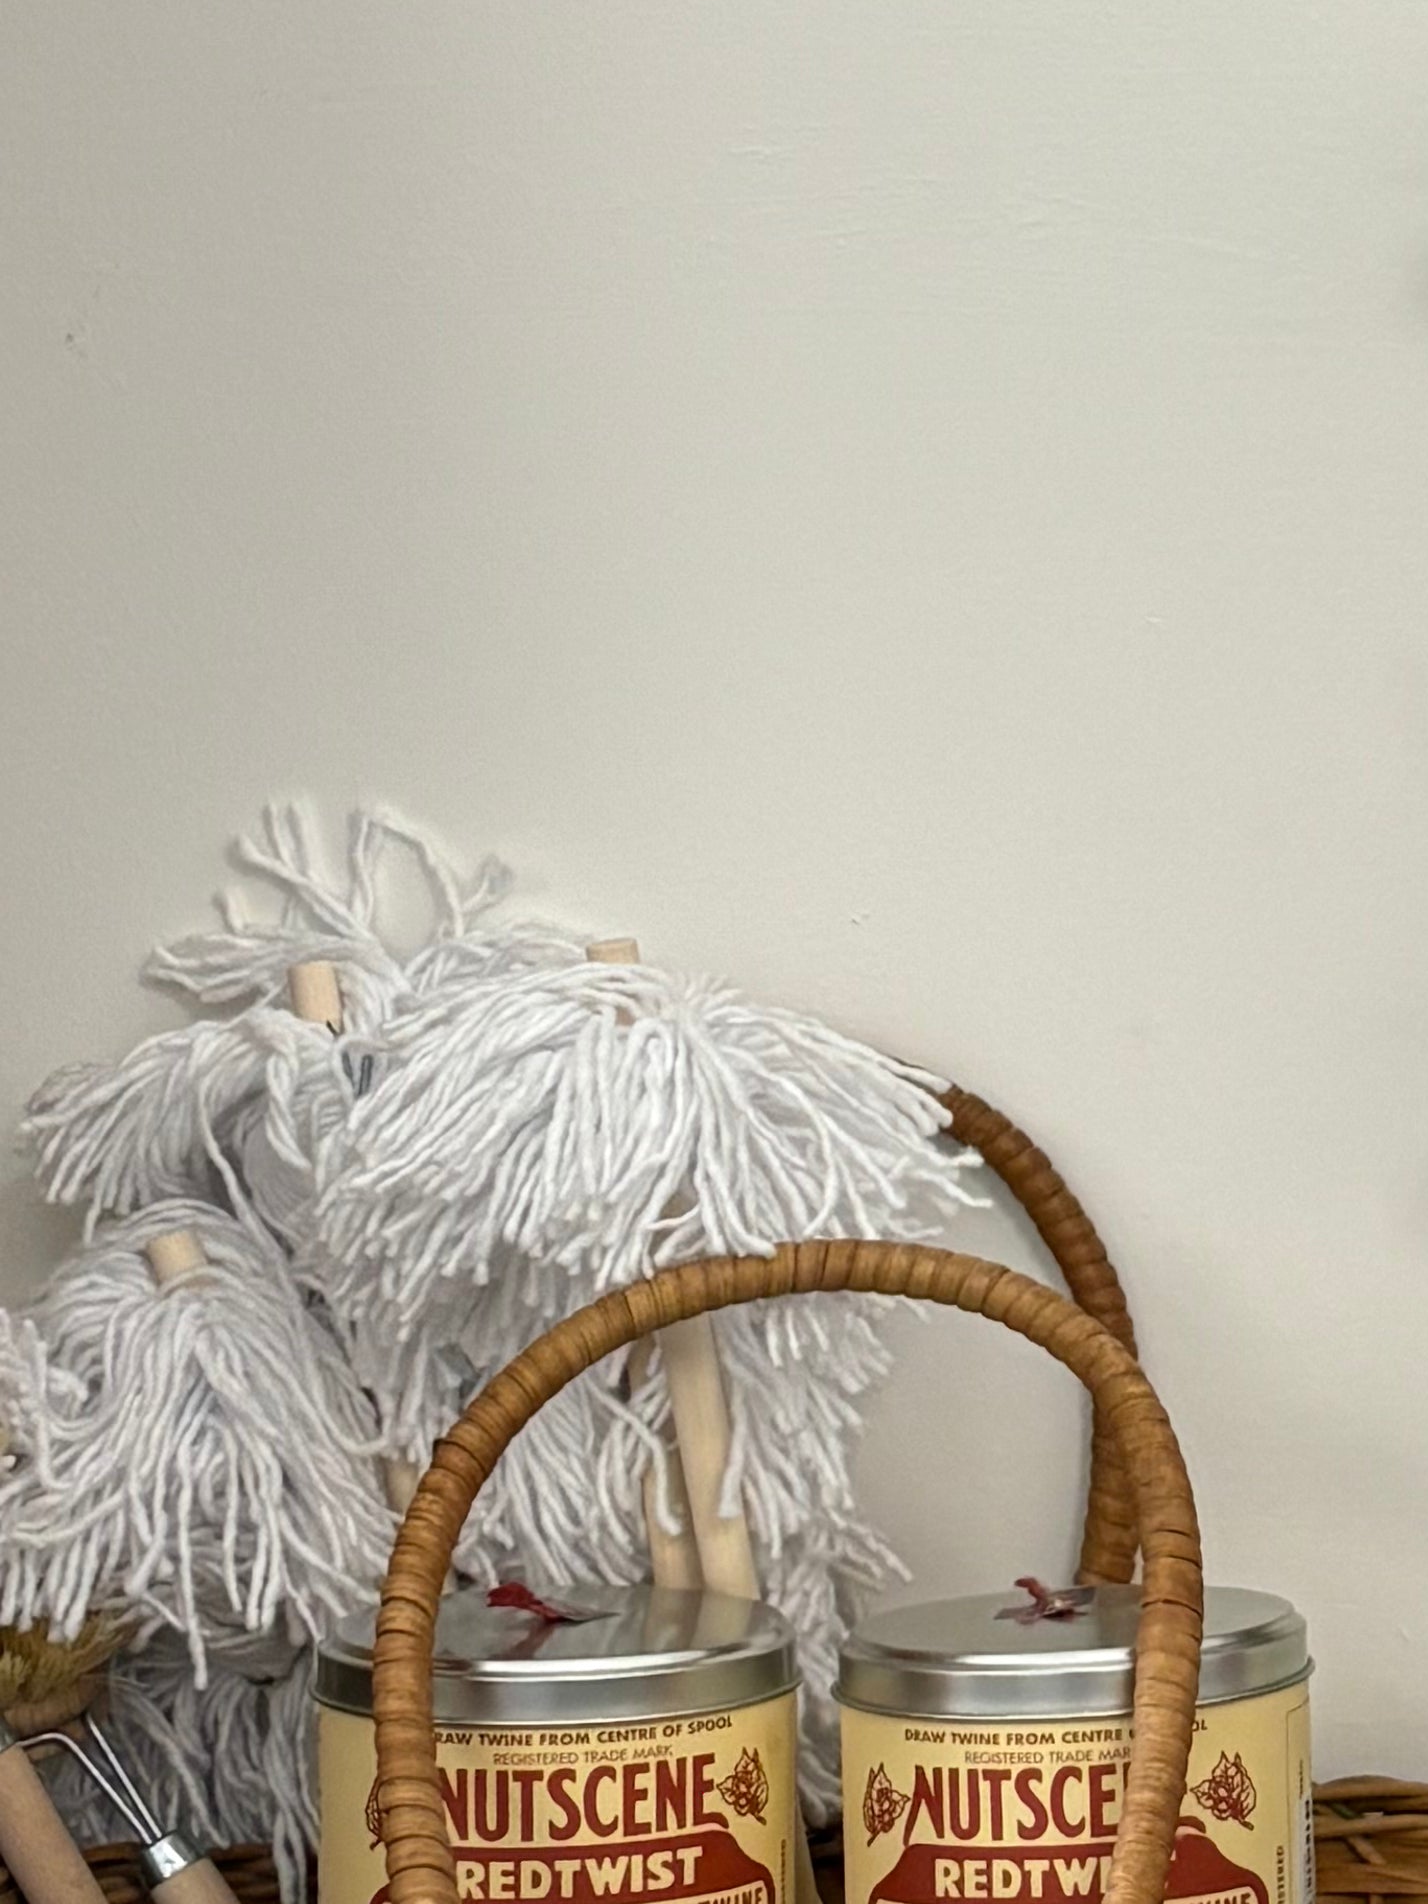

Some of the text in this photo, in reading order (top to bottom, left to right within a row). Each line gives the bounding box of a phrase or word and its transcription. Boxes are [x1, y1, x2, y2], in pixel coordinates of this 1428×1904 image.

[479, 1732, 533, 1747] TWINE
[539, 1731, 591, 1746] FROM
[597, 1727, 657, 1744] CENTRE
[662, 1724, 684, 1738] OF
[687, 1715, 734, 1735] SPOOL
[904, 1729, 945, 1744] DRAW
[951, 1731, 1000, 1746] TWINE
[1006, 1730, 1056, 1746] FROM
[1061, 1729, 1123, 1744] CENTRE
[493, 1745, 674, 1766] REGISTERED TRADE MARK
[964, 1748, 1131, 1765] REGISTERED TRADE MAR
[439, 1752, 729, 1842] NUTSCENE
[903, 1763, 1131, 1846] NUTSCE
[456, 1845, 704, 1900] REDTWIST
[935, 1856, 1112, 1899] REDTWI
